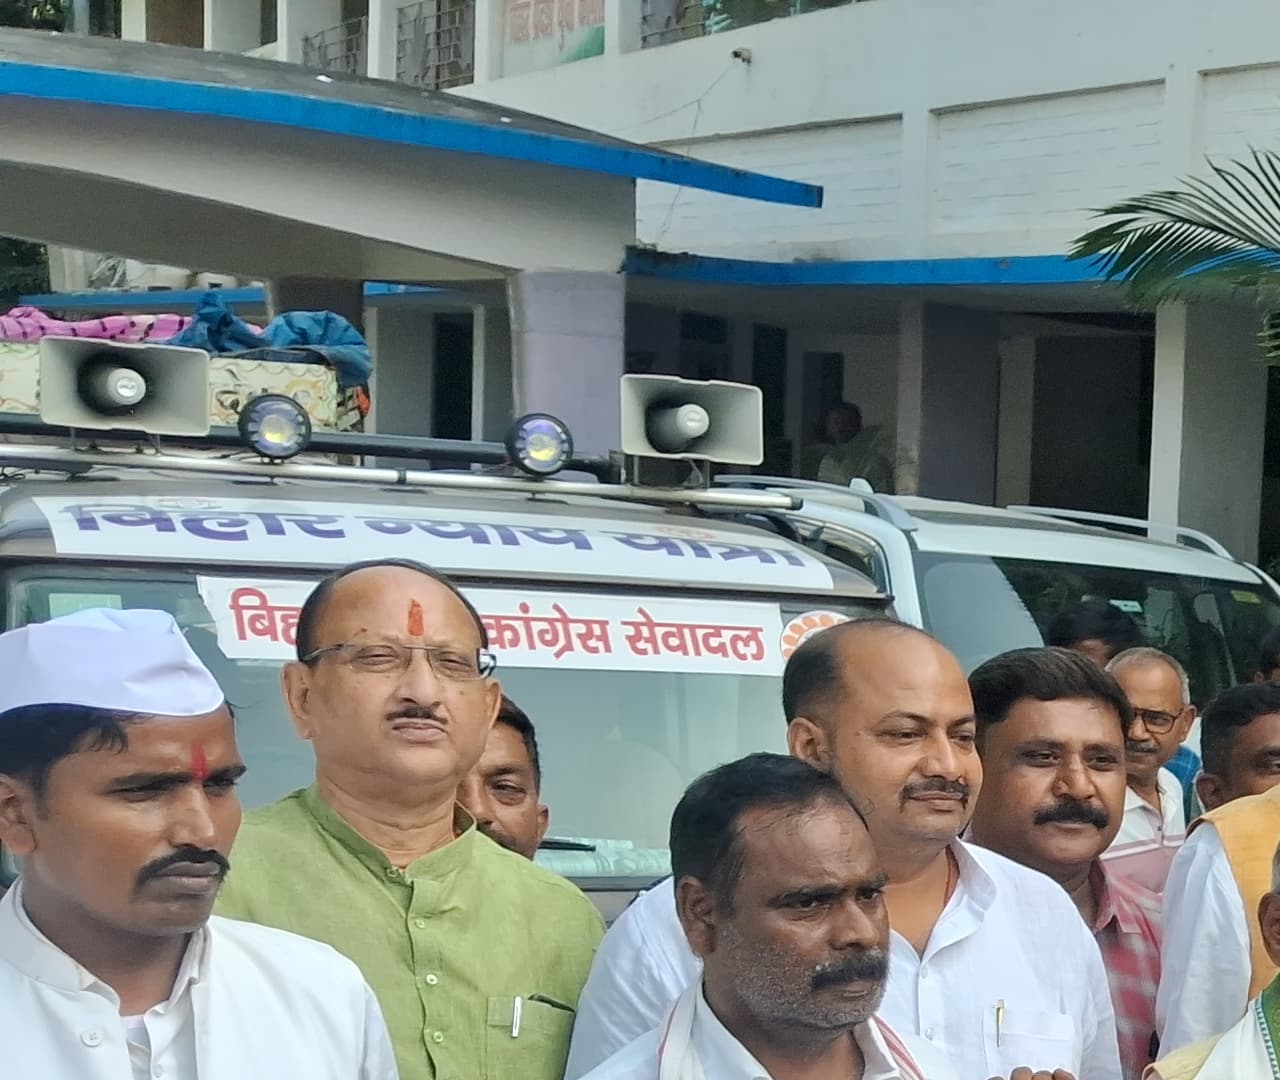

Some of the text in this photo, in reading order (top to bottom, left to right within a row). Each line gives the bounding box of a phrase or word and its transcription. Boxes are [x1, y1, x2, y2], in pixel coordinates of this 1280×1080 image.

[63, 503, 806, 567] बिहार न्याय यात्रा
[482, 601, 612, 659] कांग्रेस
[620, 607, 765, 661] सेवादल
